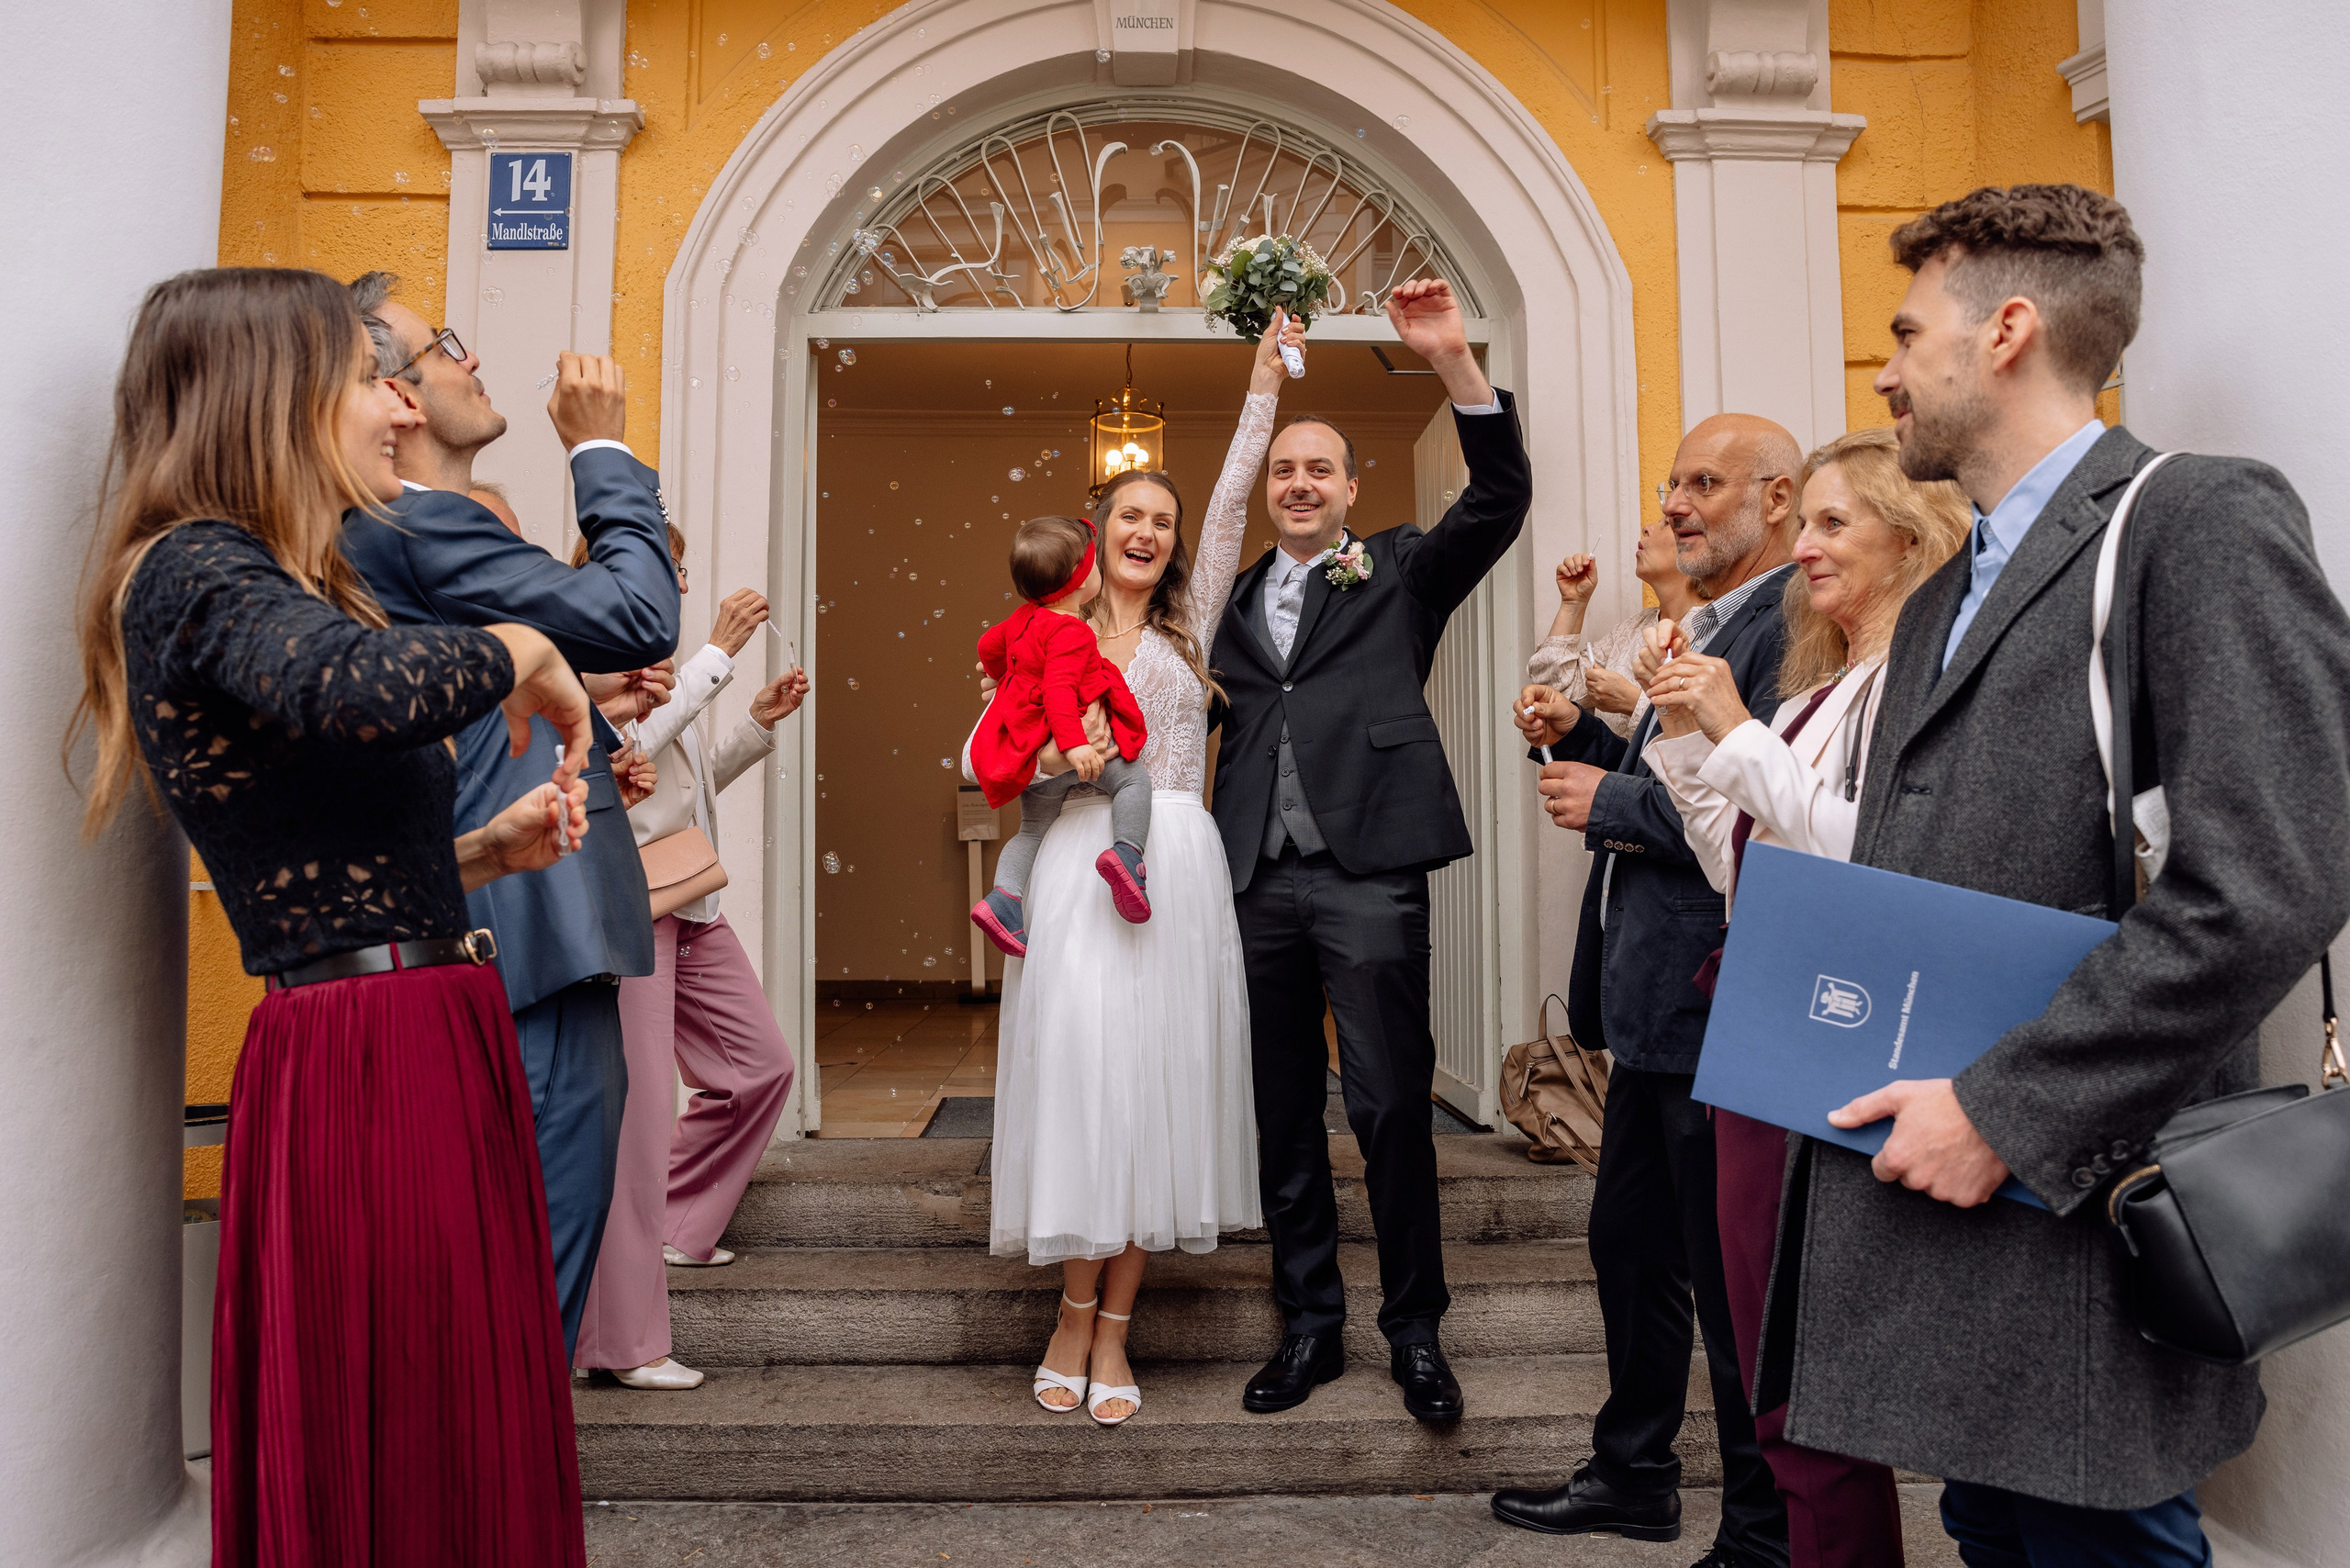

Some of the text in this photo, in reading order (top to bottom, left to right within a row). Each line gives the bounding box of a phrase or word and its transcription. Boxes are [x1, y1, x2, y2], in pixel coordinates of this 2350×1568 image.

[1115, 16, 1173, 28] MÜNCHEN
[508, 159, 552, 202] 14
[491, 222, 564, 241] Mandlstraße
[1888, 970, 1919, 1070] Standesamt München
